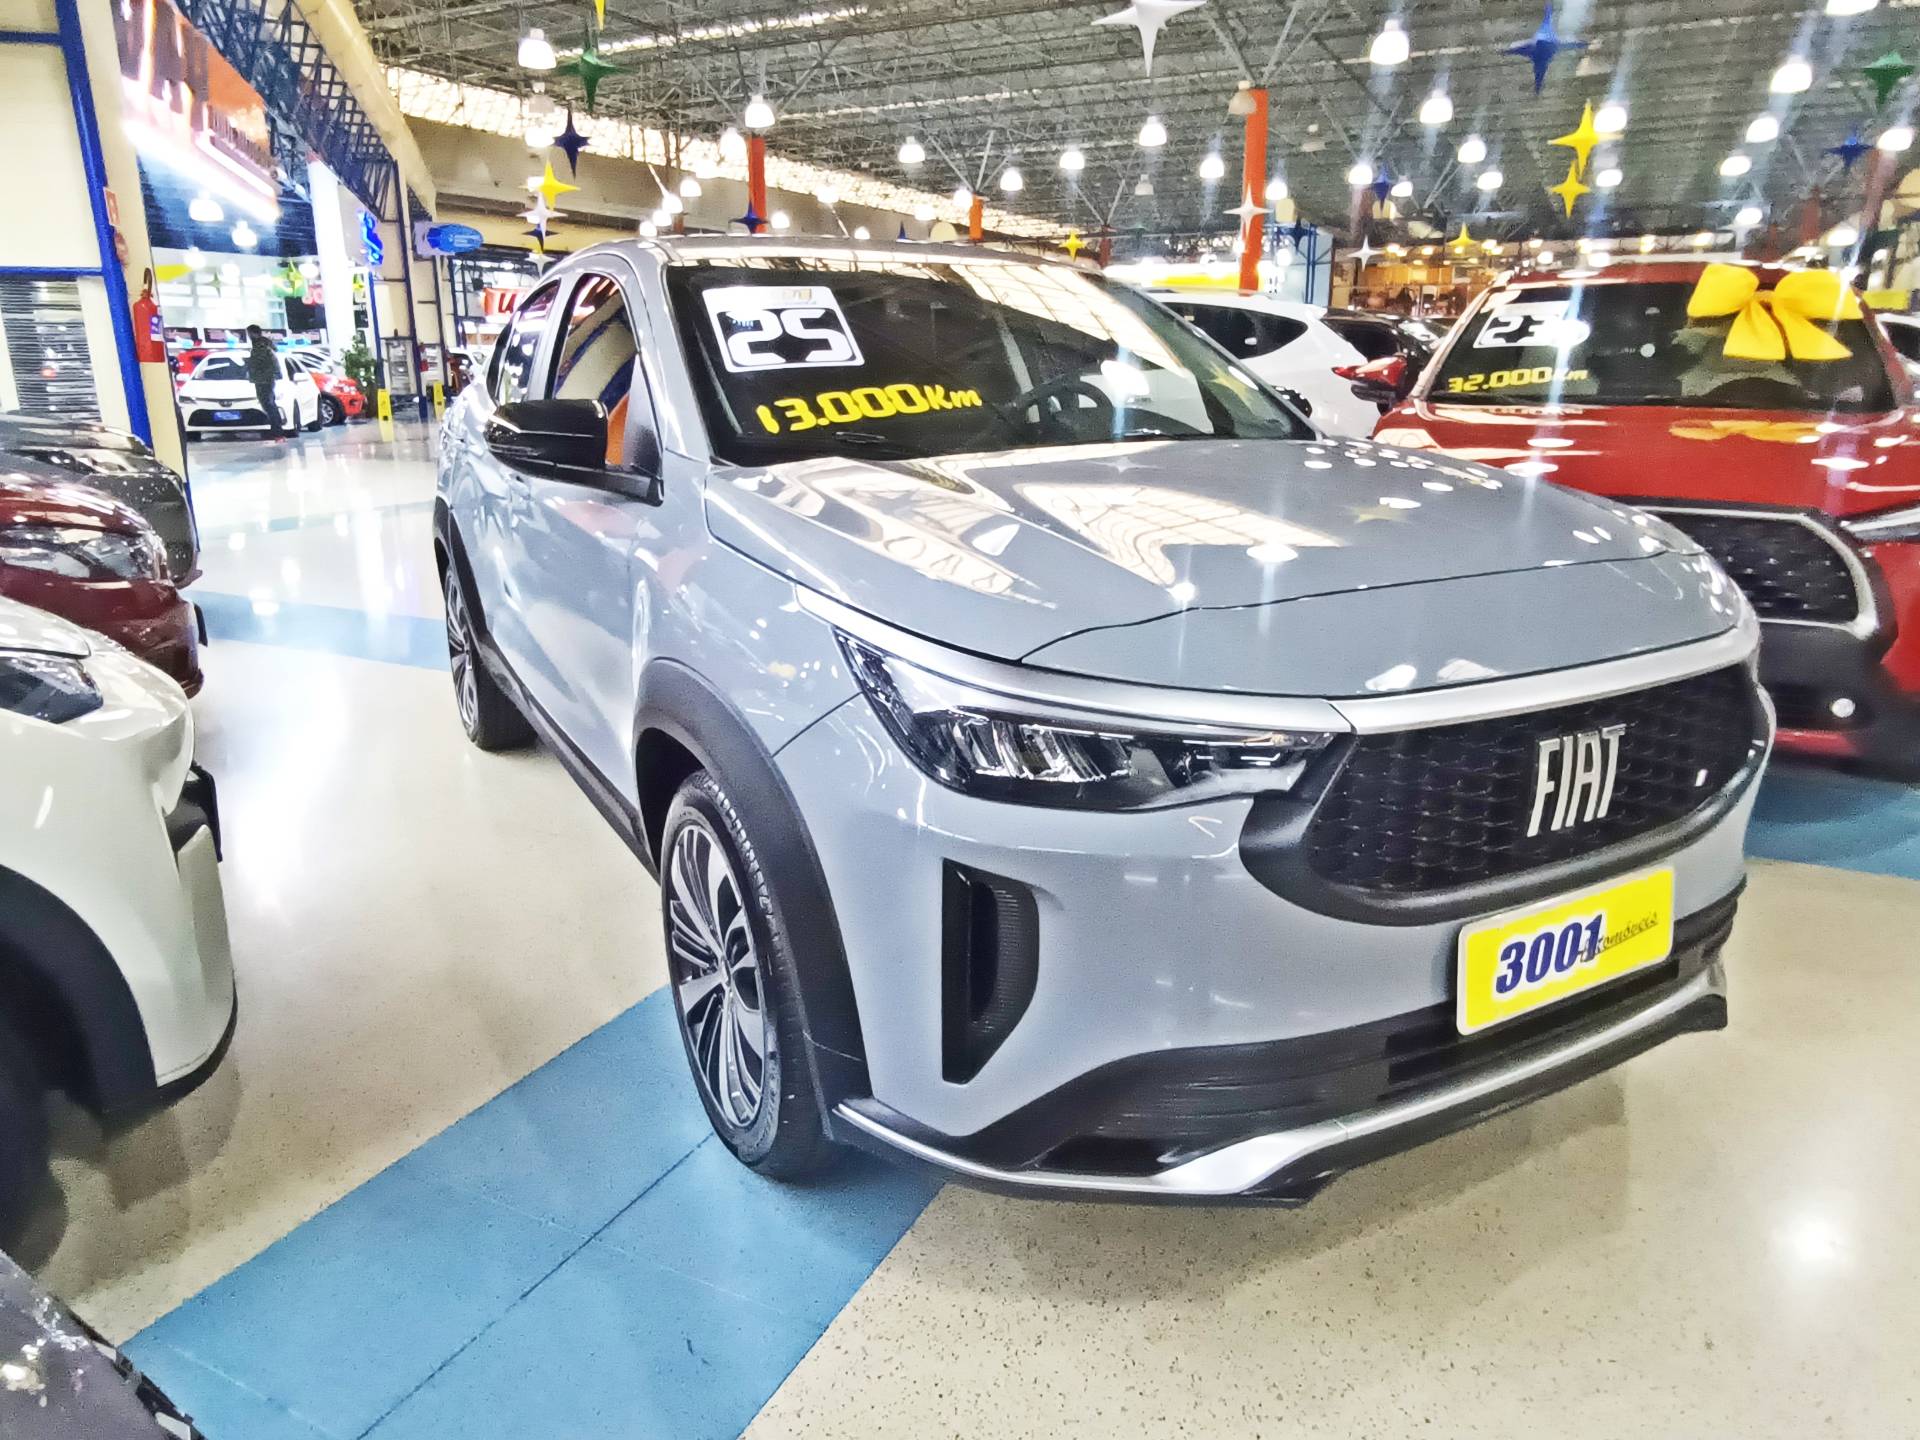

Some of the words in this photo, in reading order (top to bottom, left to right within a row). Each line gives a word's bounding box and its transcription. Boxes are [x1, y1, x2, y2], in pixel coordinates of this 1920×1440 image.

[727, 308, 853, 366] 25
[1527, 723, 1627, 838] FIAT
[1495, 914, 1604, 993] 3001
